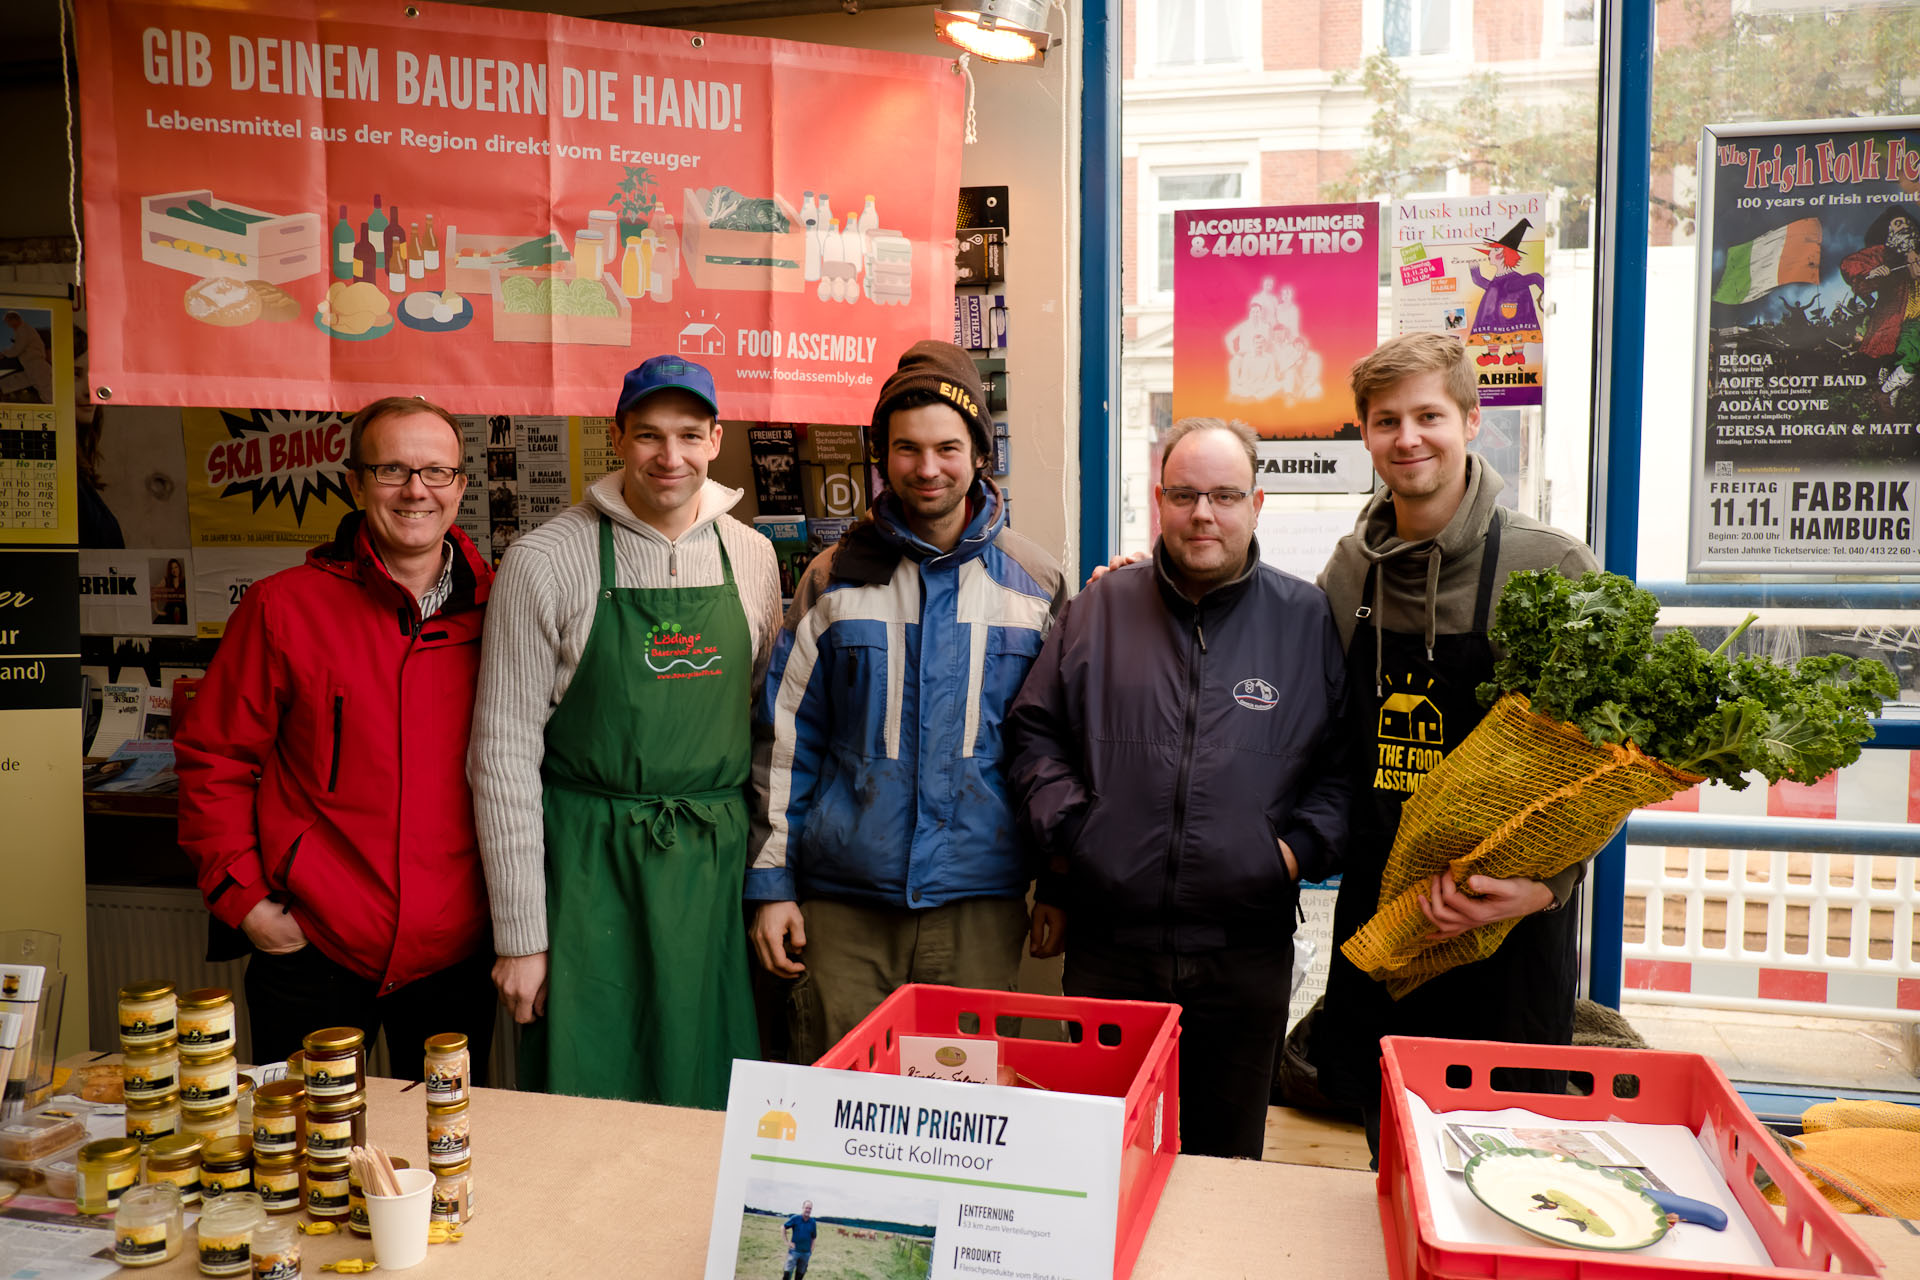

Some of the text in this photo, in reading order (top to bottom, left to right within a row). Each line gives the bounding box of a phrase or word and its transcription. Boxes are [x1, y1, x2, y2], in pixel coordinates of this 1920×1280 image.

[142, 26, 743, 132] GIB DEINEM BAUERN DIE HAND!
[145, 109, 701, 171] Lebensmittel aus der Region direkt vom Erzeuger
[1718, 136, 1920, 193] The Irish Folk Fe
[1399, 198, 1539, 220] Musik und Spaß
[1736, 191, 1920, 210] 100 years of Irish revolut
[1188, 214, 1365, 236] JACQUES PALMINGER
[1399, 221, 1496, 241] für Kinder!
[1189, 230, 1363, 258] & 440HZ TRIO
[970, 298, 981, 347] POTHEAD
[737, 328, 877, 364] FOOD ASSEMBLY
[1718, 353, 1774, 367] BEOGA
[736, 366, 873, 386] www.foodassembly.de
[1479, 371, 1538, 385] ABRIK
[1718, 374, 1867, 389] AOIFE SCOTT BAND
[939, 382, 979, 417] Elite
[1717, 397, 1830, 412] AODÁN COYNE
[1730, 413, 1752, 421] beauty
[1761, 412, 1792, 421] simplicity
[754, 430, 793, 440] FREIHEIT 36
[815, 430, 853, 438] Deutsches
[1716, 423, 1912, 437] TERESA HORGAN & MATT
[528, 435, 558, 443] HUMAN
[528, 443, 558, 452] LEAGUE
[1716, 438, 1742, 446] Heading
[207, 423, 346, 484] SKA BANG
[17, 489, 29, 497] ho
[38, 480, 53, 490] nig
[1710, 481, 1778, 494] FREITAG
[17, 499, 54, 509] ho ney
[530, 496, 560, 505] KILLING
[1791, 481, 1910, 512] FABRIK
[15, 510, 32, 519] por
[530, 505, 550, 513] JOKE
[1710, 498, 1779, 527] 11.11.
[1708, 532, 1780, 542] Beginn: 20.00 Uhr
[1789, 516, 1911, 541] HAMBURG
[1708, 546, 1739, 555] Karsten
[1741, 546, 1772, 555] Jahnke
[1773, 546, 1831, 556] Ticketservice:
[1832, 546, 1847, 555] Tel.
[1887, 546, 1898, 555] 22
[1899, 546, 1911, 555] 60
[80, 577, 137, 595] BRIK
[0, 591, 34, 608] er
[0, 629, 20, 645] ur
[0, 660, 46, 684] and)
[1377, 743, 1444, 772] THE FOOD
[1373, 768, 1427, 793] ASSEM
[834, 1098, 1009, 1146] MARTIN PRIGNITZ
[844, 1137, 994, 1172] Gestüt Kollmoor
[963, 1204, 1014, 1222] ENTFERNUNG
[973, 1222, 984, 1230] km
[985, 1224, 1000, 1232] zum
[1001, 1225, 1052, 1238] Verteilungsort
[960, 1246, 1002, 1264] PRODUKTE
[959, 1263, 1014, 1278] Fleischprodukte
[1015, 1270, 1032, 1279] vom
